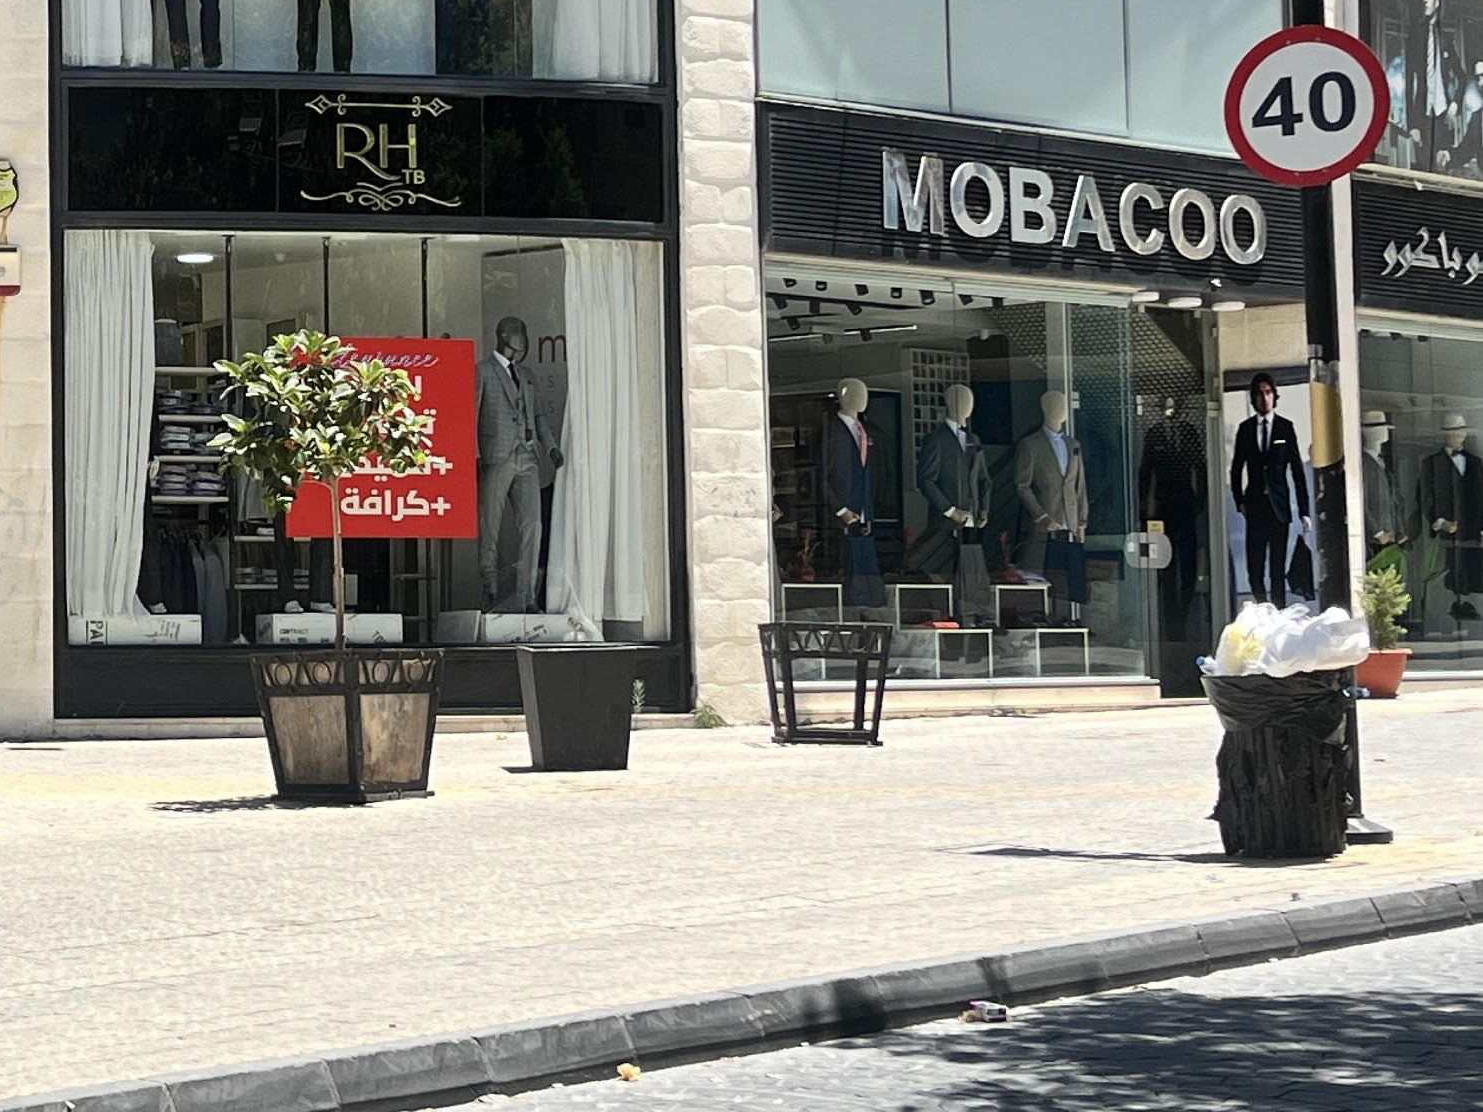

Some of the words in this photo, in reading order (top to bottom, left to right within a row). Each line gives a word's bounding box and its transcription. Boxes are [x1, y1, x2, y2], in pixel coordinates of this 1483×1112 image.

[1251, 71, 1357, 137] 40
[335, 122, 418, 182] RH
[881, 147, 1268, 266] MOBACOO
[1380, 226, 1483, 285] وباكوو
